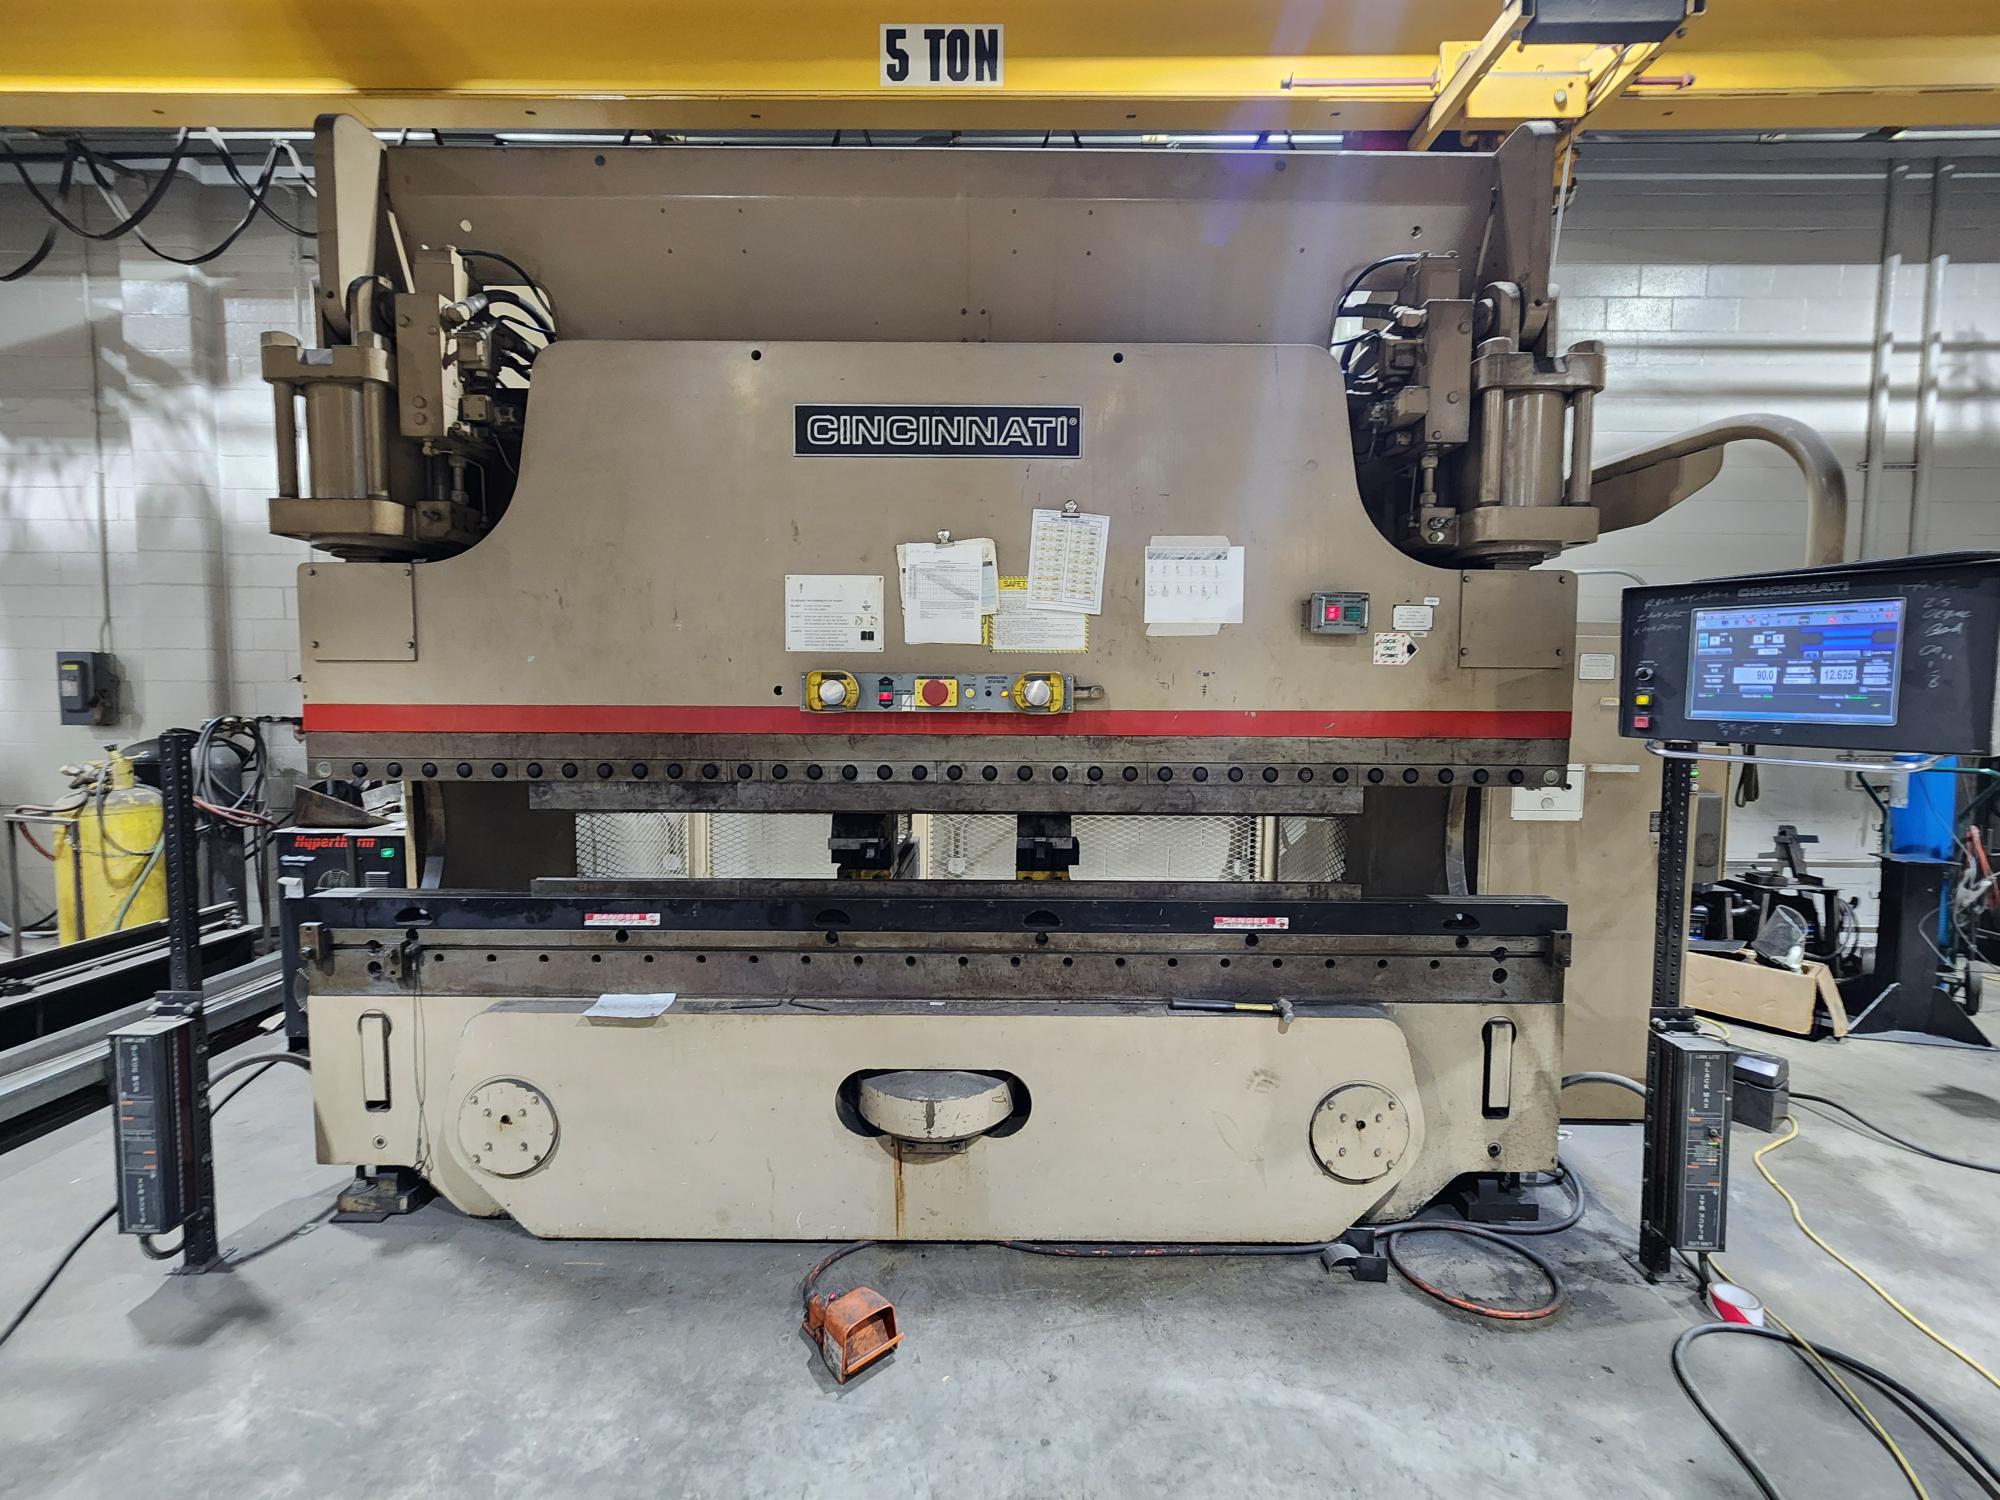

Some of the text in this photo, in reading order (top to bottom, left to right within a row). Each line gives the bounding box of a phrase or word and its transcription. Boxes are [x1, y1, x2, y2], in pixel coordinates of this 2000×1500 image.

[886, 29, 998, 81] 5 TON
[807, 415, 1069, 446] CINCINNATI
[1003, 580, 1028, 588] SAFET
[1737, 581, 1849, 597] CINCINNATI
[1757, 670, 1774, 681] 90.0
[1825, 669, 1853, 680] 12.625
[294, 836, 377, 850] Hyperthrm
[1703, 1061, 1711, 1089] BLACK
